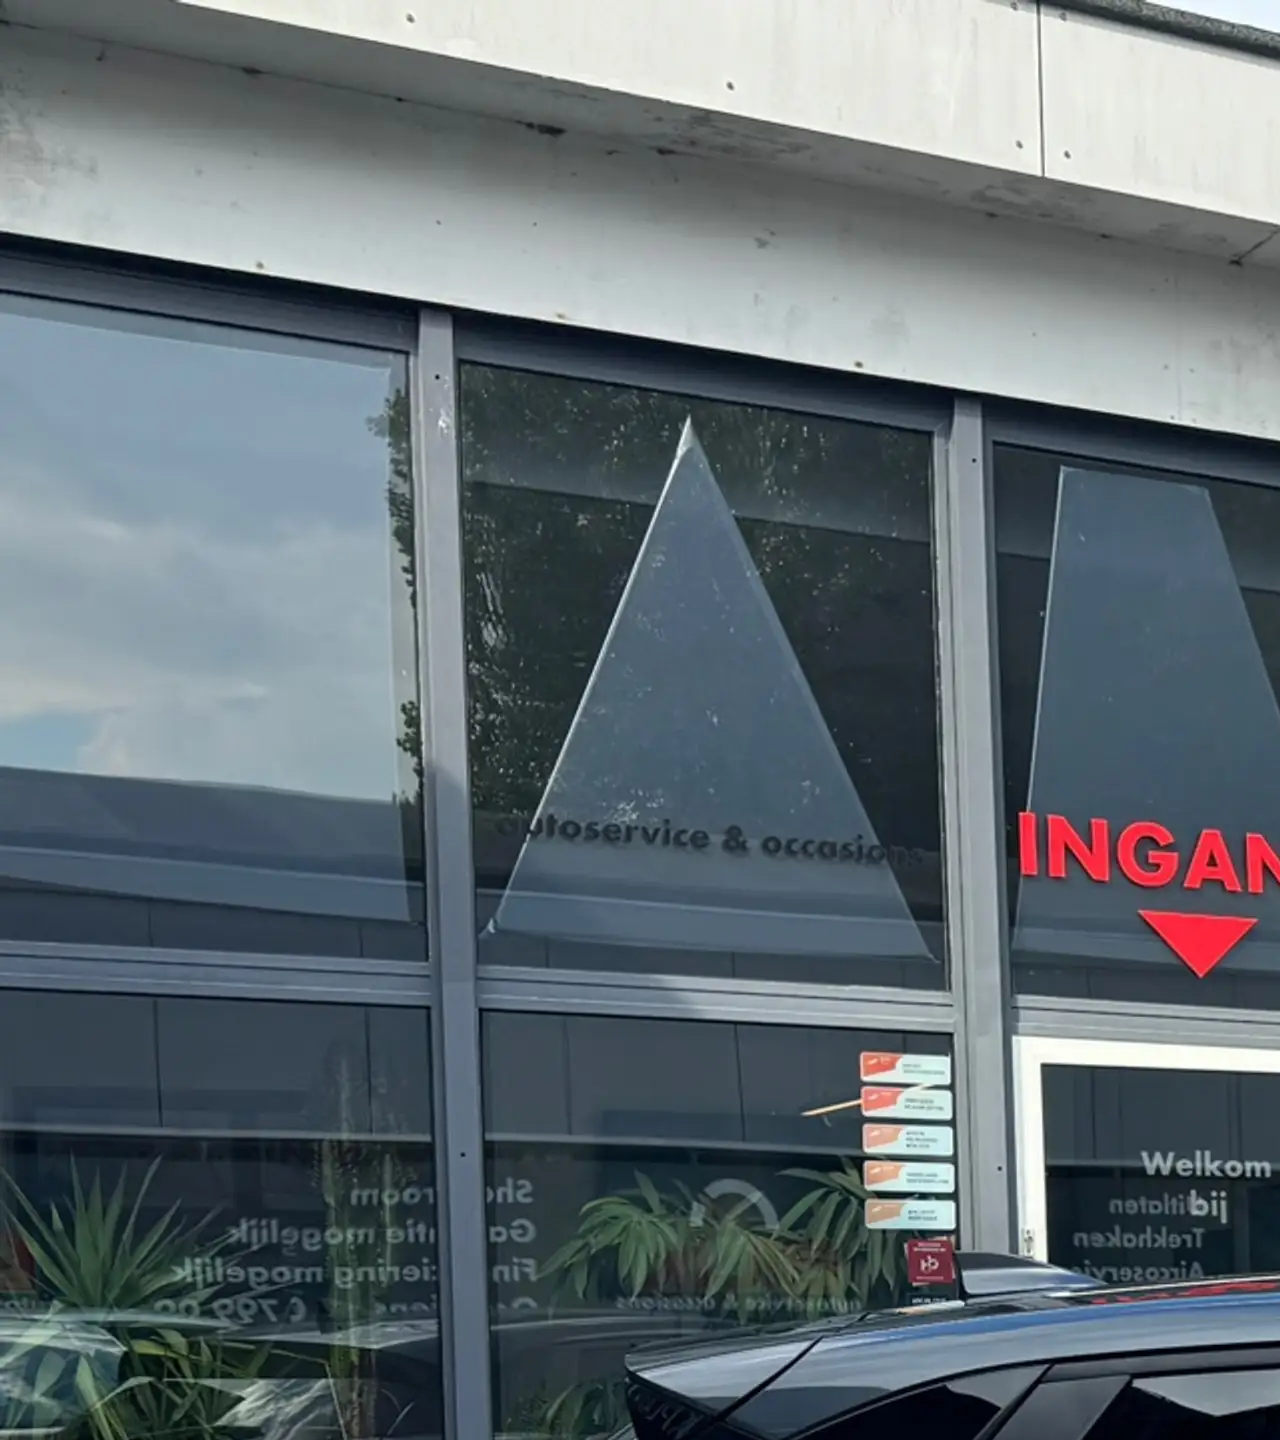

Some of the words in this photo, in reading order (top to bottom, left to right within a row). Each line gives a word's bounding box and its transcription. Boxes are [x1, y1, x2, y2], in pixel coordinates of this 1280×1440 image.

[497, 816, 710, 852] autoservice
[722, 824, 749, 855] &
[761, 833, 924, 867] occasions
[1139, 1149, 1272, 1179] Welkom
